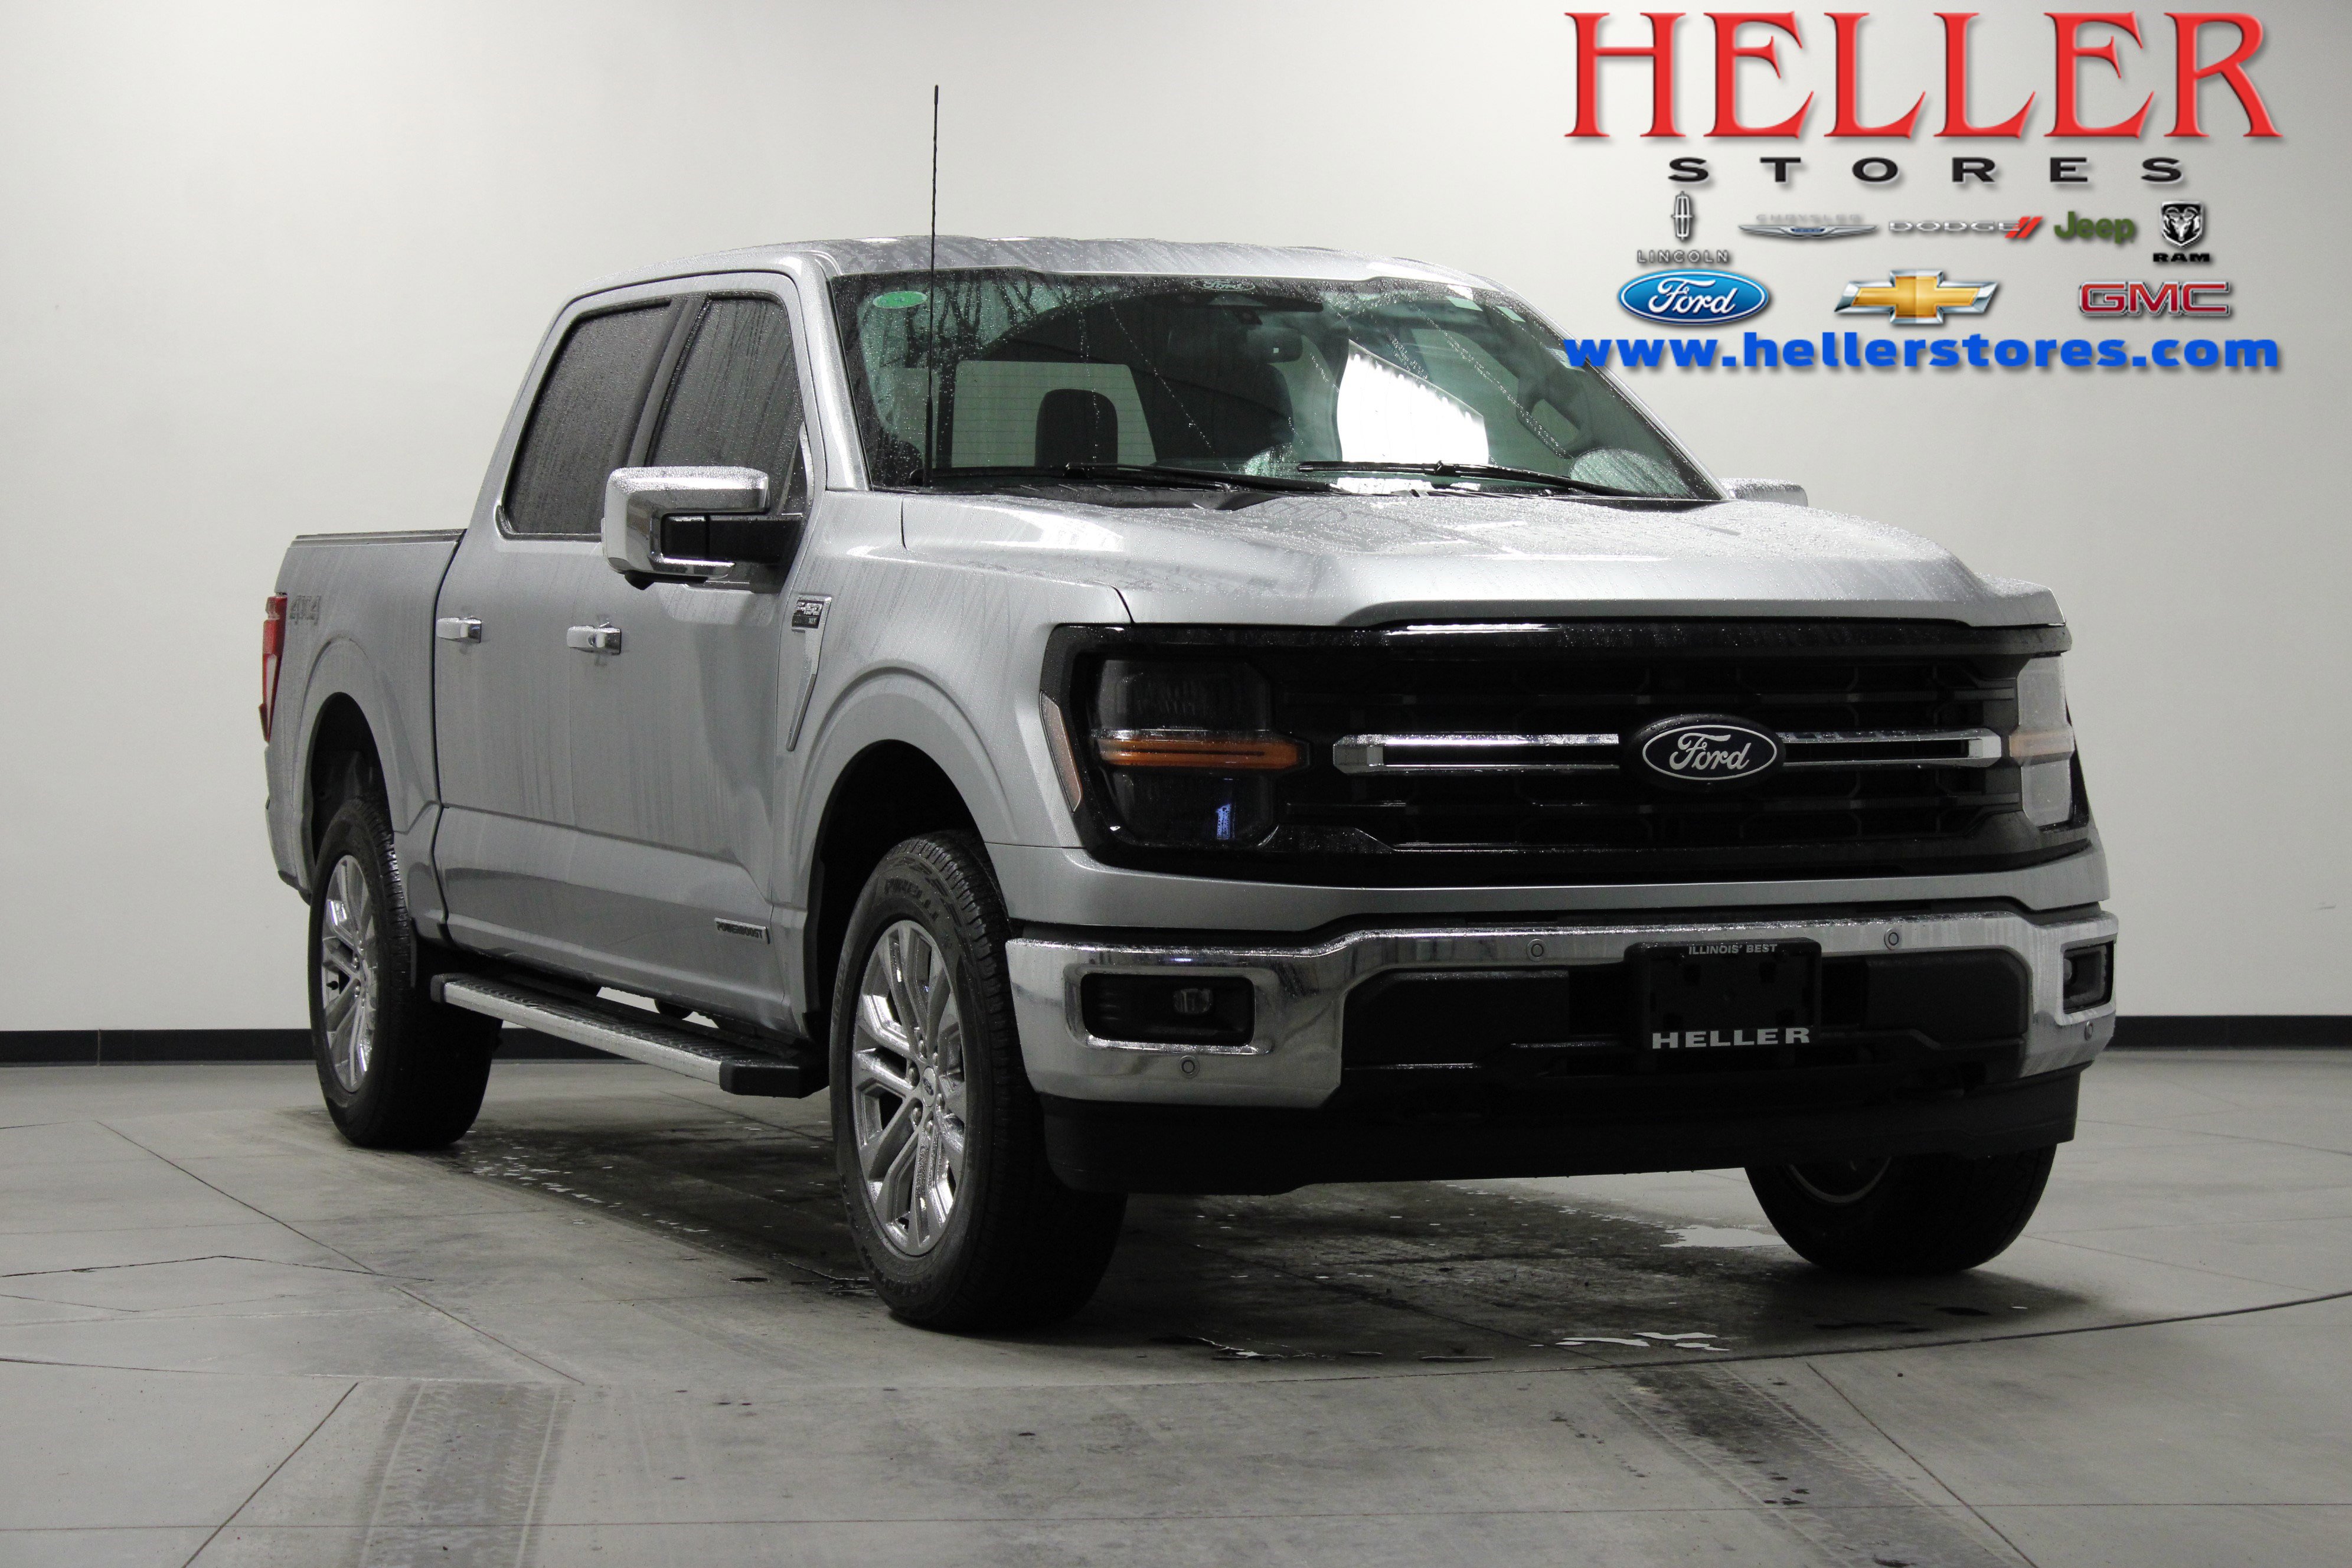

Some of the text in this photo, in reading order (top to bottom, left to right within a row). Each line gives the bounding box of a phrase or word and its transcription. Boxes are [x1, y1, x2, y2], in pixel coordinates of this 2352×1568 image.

[1669, 732, 1752, 770] Ford
[1688, 943, 1778, 955] ILLINOIS' BEST
[1652, 1027, 1811, 1049] HELLER
